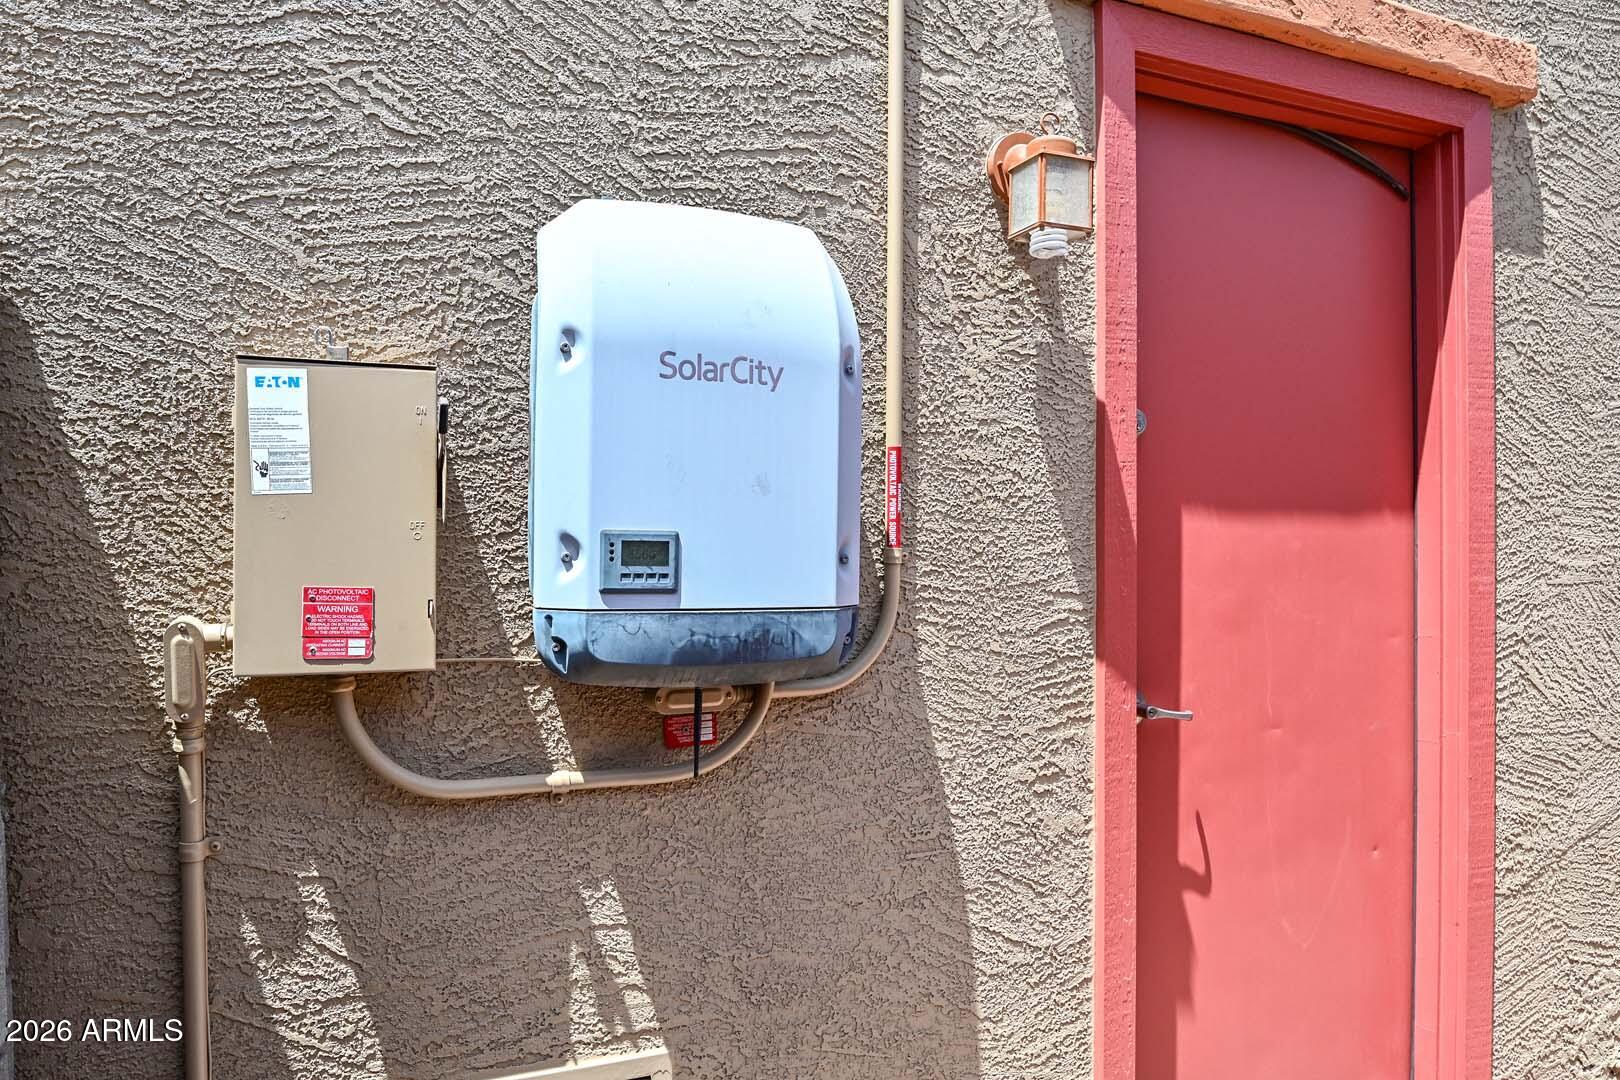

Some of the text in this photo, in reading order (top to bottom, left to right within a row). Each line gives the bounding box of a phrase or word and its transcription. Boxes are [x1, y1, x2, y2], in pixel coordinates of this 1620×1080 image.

[659, 350, 784, 392] SolarCity
[254, 376, 301, 388] EATON
[416, 404, 427, 416] ON
[889, 450, 897, 546] PHOTOVOLTAIC POWER SOURCE
[410, 520, 425, 531] OFF
